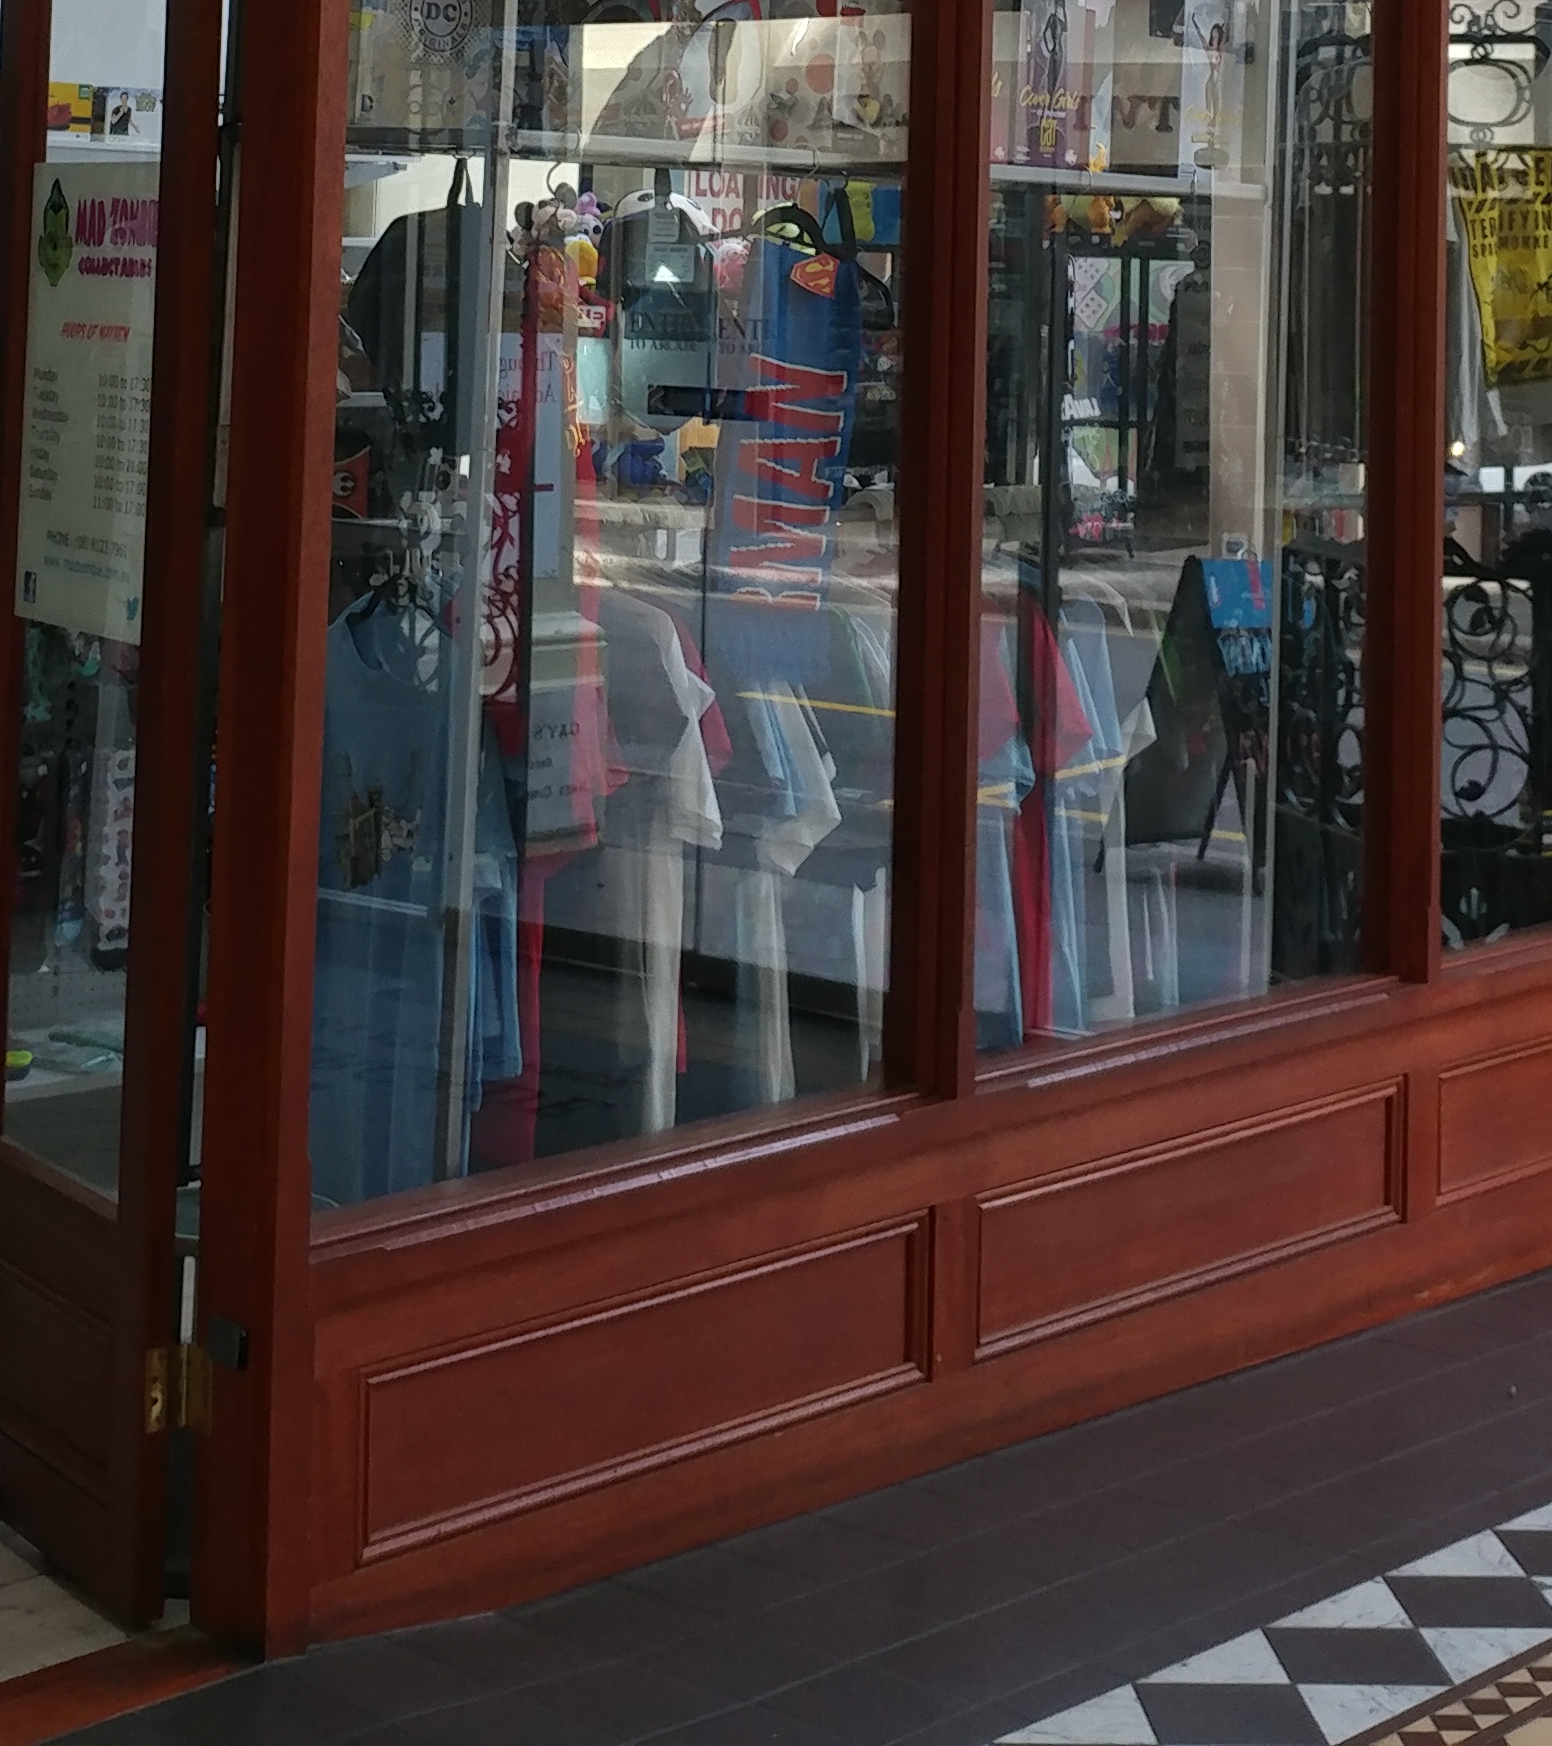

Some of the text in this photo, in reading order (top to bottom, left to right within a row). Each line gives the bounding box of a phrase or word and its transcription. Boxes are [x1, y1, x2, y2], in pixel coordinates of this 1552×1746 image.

[425, 2, 458, 23] DC
[695, 170, 797, 201] LOAING
[75, 198, 106, 248] MAD
